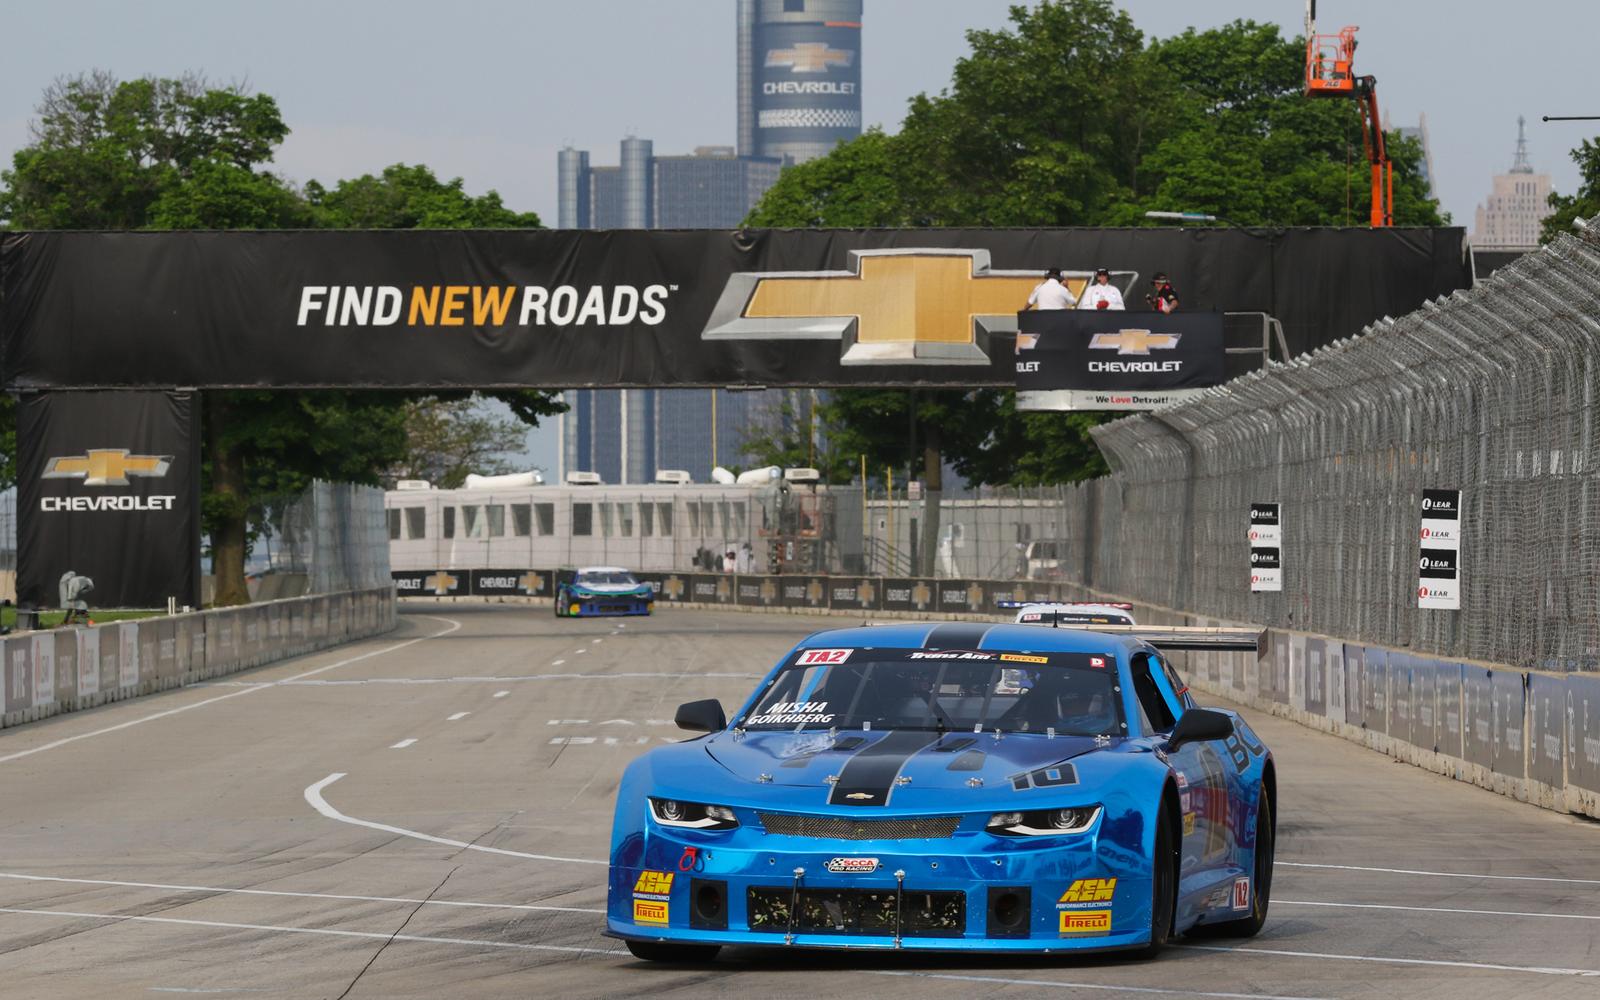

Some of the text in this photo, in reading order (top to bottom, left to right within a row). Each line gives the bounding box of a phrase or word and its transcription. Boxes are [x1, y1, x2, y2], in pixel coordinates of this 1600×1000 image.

[763, 81, 856, 95] CHEVROLET
[297, 286, 403, 326] FIND
[407, 286, 516, 326] NEW
[1088, 360, 1183, 373] CHEVROLET
[1095, 395, 1110, 404] We
[1111, 395, 1131, 404] Love
[40, 495, 177, 512] CHEVROLET
[805, 651, 846, 663] TA2
[765, 701, 828, 714] MISHA
[747, 714, 836, 725] GOIKHBERG
[633, 870, 675, 894] AEM
[1058, 877, 1118, 902] AEM
[1235, 881, 1248, 907] TA2
[636, 904, 665, 919] PIRELLI
[1065, 914, 1107, 928] PIRELLI
